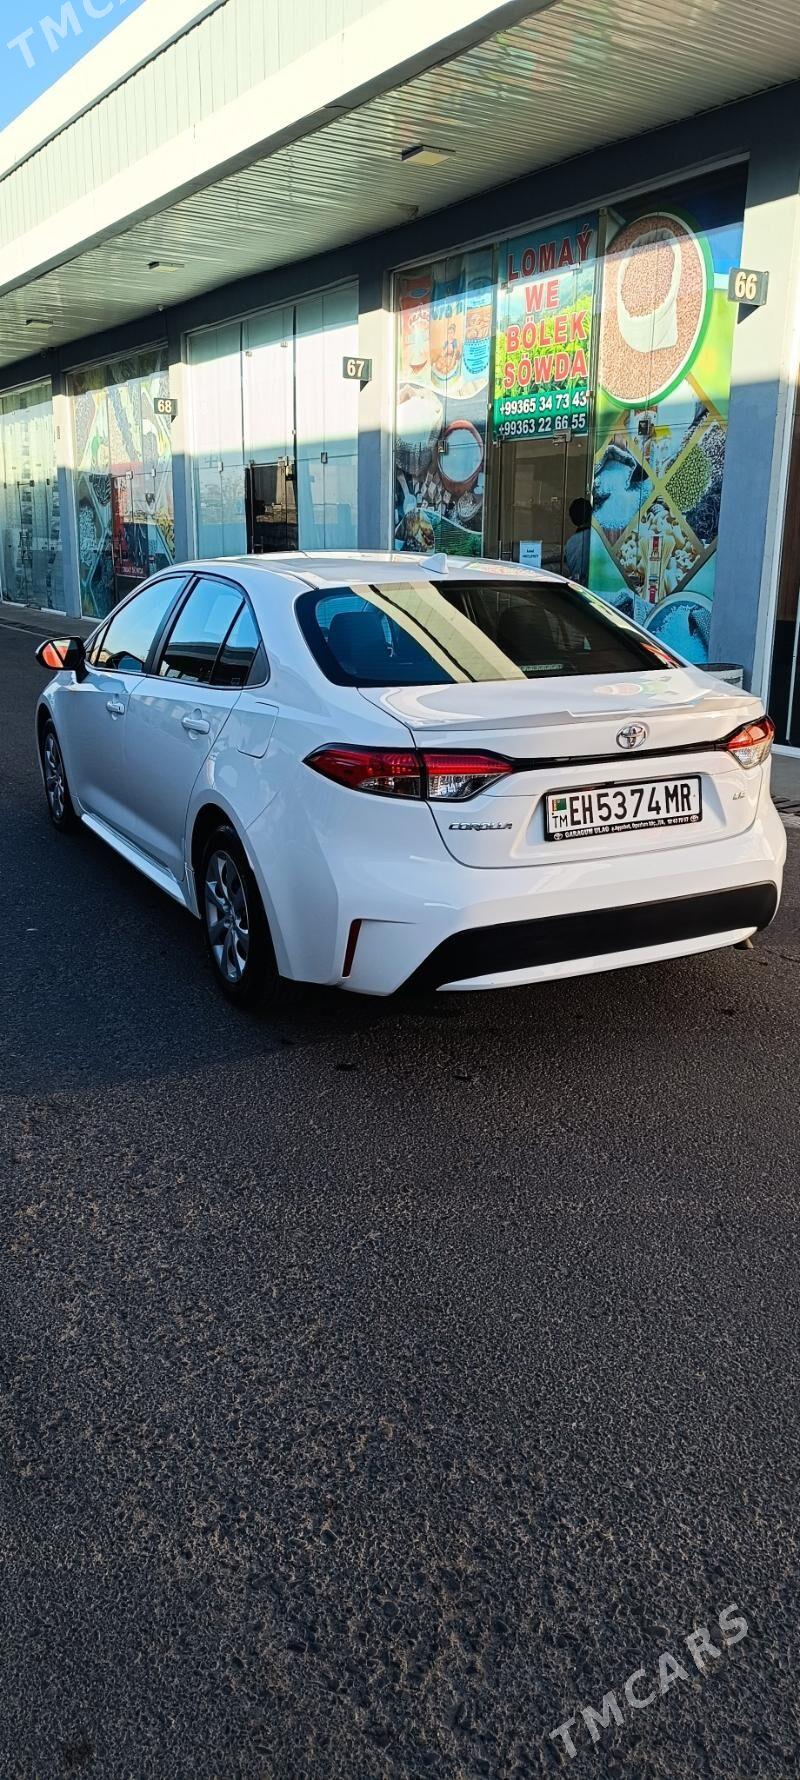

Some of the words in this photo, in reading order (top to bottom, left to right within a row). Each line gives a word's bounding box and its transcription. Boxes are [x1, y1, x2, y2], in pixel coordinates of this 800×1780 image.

[506, 223, 593, 283] LOMAÝ
[524, 279, 560, 315] WE
[734, 271, 758, 300] 66
[505, 310, 588, 354] BÖLEK
[346, 359, 365, 377] 67
[503, 348, 588, 390] SÖWDA
[157, 400, 172, 414] 68
[500, 397, 537, 416] +99365
[539, 395, 553, 412] 34
[555, 393, 570, 410] 73
[572, 391, 587, 407] 43
[499, 418, 536, 436] +99363
[538, 416, 552, 433] 22
[555, 415, 569, 430] 66
[571, 413, 586, 429] 55
[448, 821, 513, 831] COROLLA
[552, 814, 568, 829] TM
